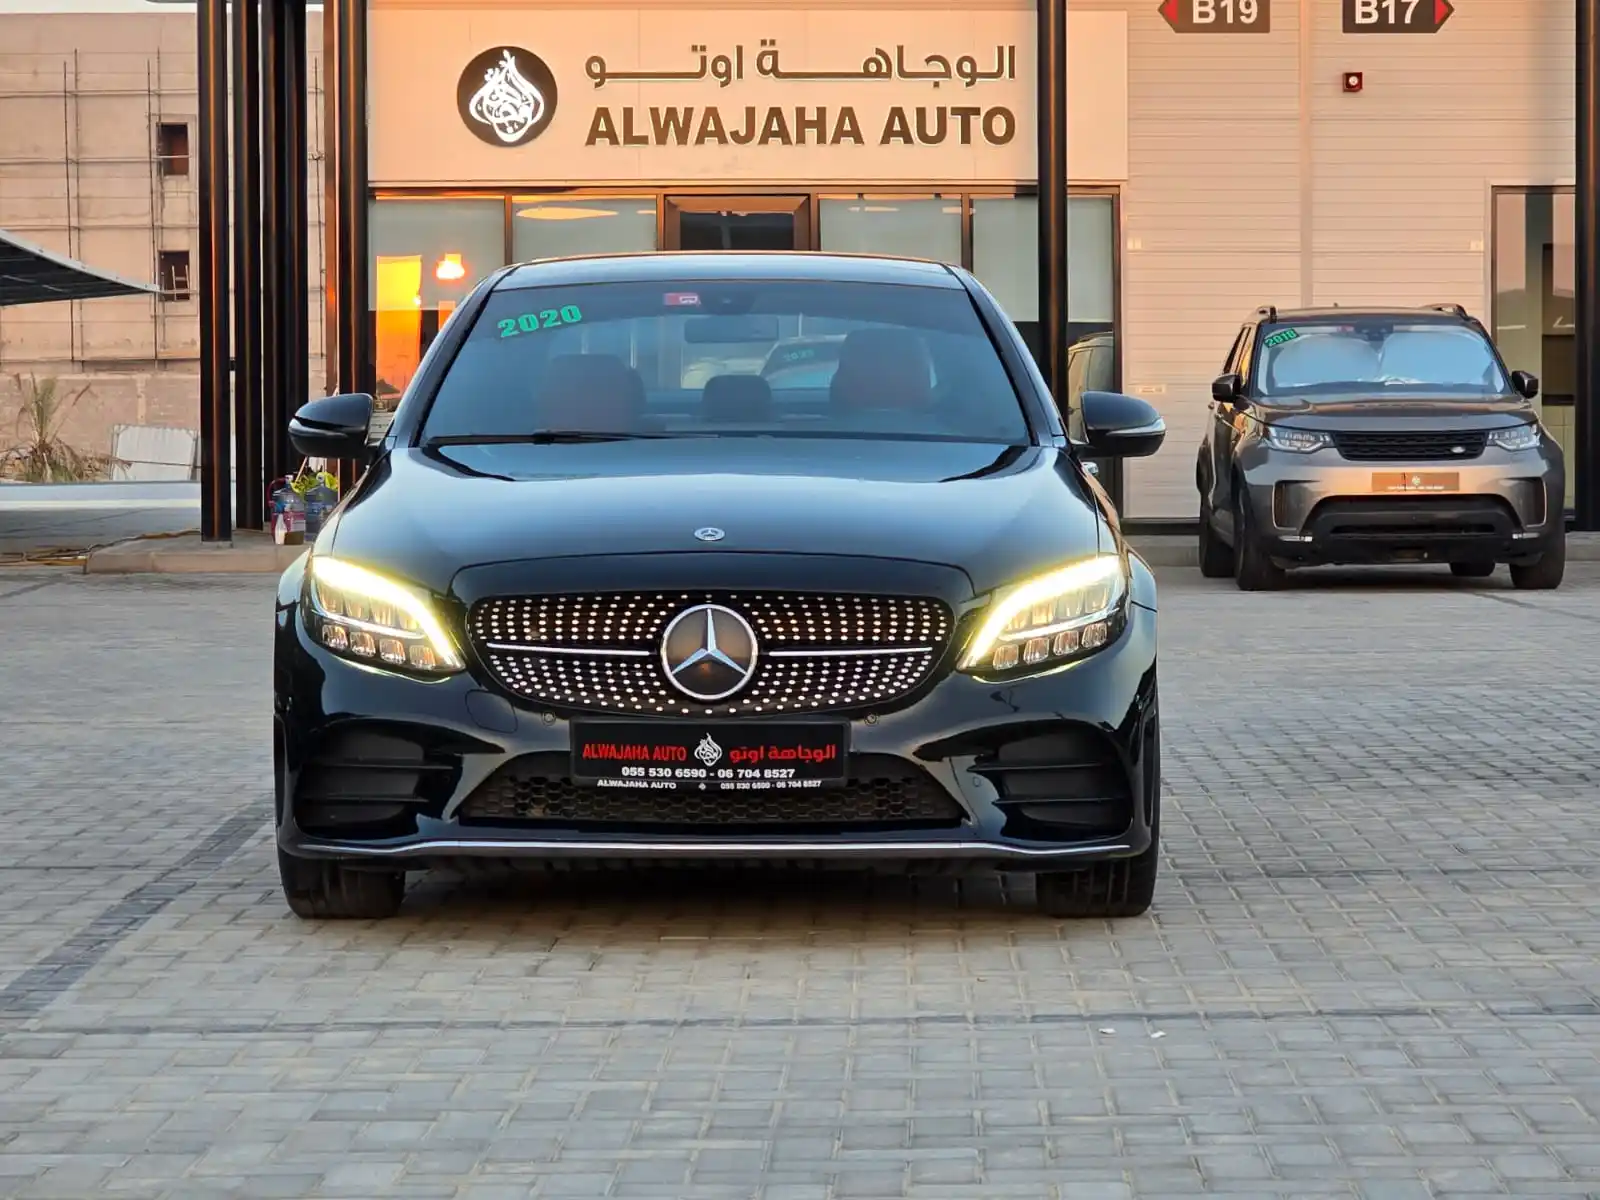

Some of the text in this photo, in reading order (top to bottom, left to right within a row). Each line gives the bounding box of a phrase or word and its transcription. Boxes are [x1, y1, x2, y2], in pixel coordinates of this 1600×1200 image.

[1192, 0, 1258, 24] B19
[1355, 0, 1420, 24] B17
[585, 106, 1016, 145] ALWAJAHA AUTO
[497, 304, 582, 338] 2020
[582, 744, 650, 760] ALWAJAHA
[653, 746, 687, 761] AUTO
[597, 779, 677, 789] ALWAJAHA AUTO
[621, 766, 645, 777] 055
[648, 767, 672, 777] 530
[675, 768, 706, 778] 6590
[737, 769, 761, 778] 704
[764, 769, 795, 778] 8527
